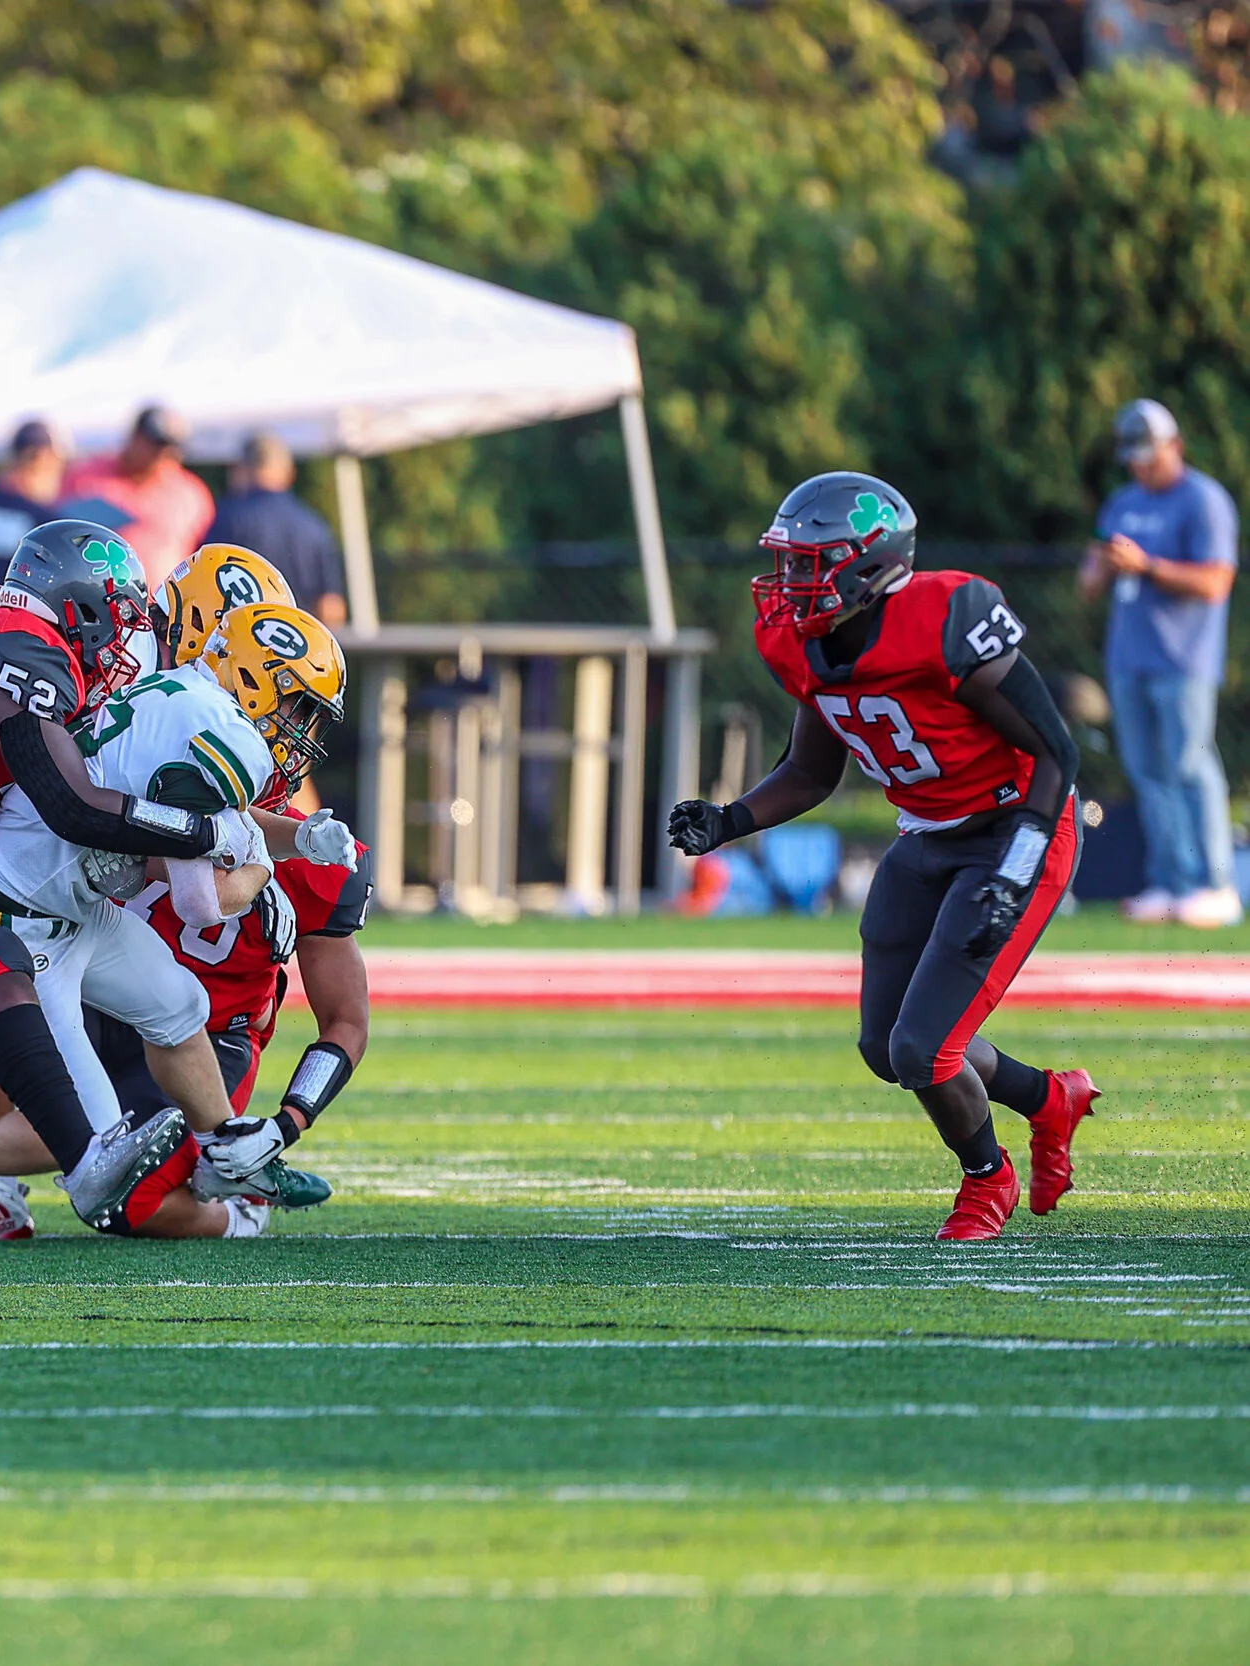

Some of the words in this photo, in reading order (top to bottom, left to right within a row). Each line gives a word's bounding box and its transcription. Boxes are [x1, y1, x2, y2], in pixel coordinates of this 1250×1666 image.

[964, 602, 1025, 662] 53
[814, 693, 943, 789] 53
[998, 786, 1013, 798] XL
[231, 1014, 248, 1025] 2XL
